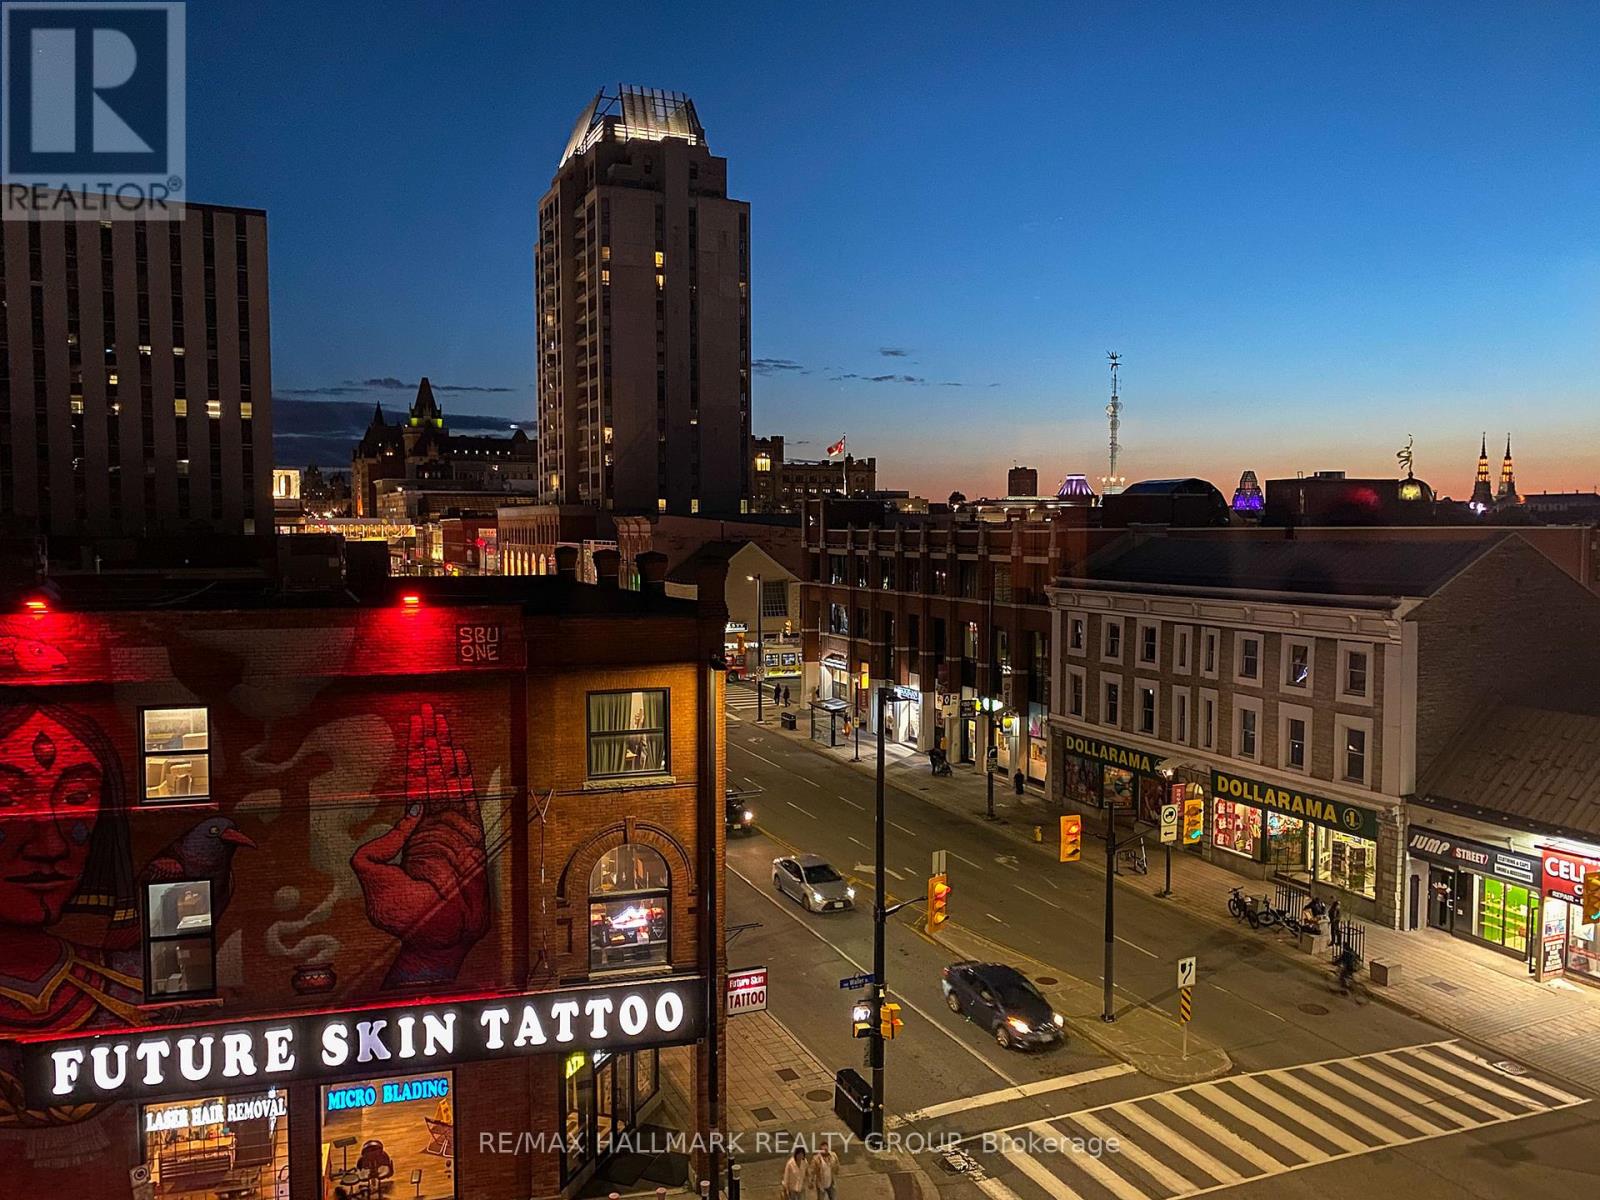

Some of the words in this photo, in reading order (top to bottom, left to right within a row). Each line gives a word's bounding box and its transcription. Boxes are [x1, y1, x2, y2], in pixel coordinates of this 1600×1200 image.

[460, 627, 498, 643] SBU
[461, 644, 499, 662] ONE
[1066, 735, 1151, 772] DOLLARAMA
[1217, 775, 1338, 824] DOLLARAMA
[1409, 834, 1451, 855] JUMP
[750, 975, 764, 985] Skin
[729, 990, 765, 1009] TATTOO
[50, 1028, 296, 1095] FUTURE
[321, 1012, 457, 1067] SKIN
[480, 991, 684, 1050] TATTOO
[327, 1087, 376, 1111] MICRO
[382, 1077, 449, 1104] BLADING
[146, 1106, 189, 1132] LASER
[191, 1103, 225, 1127] HAIR
[227, 1096, 287, 1122] REMOVAL
